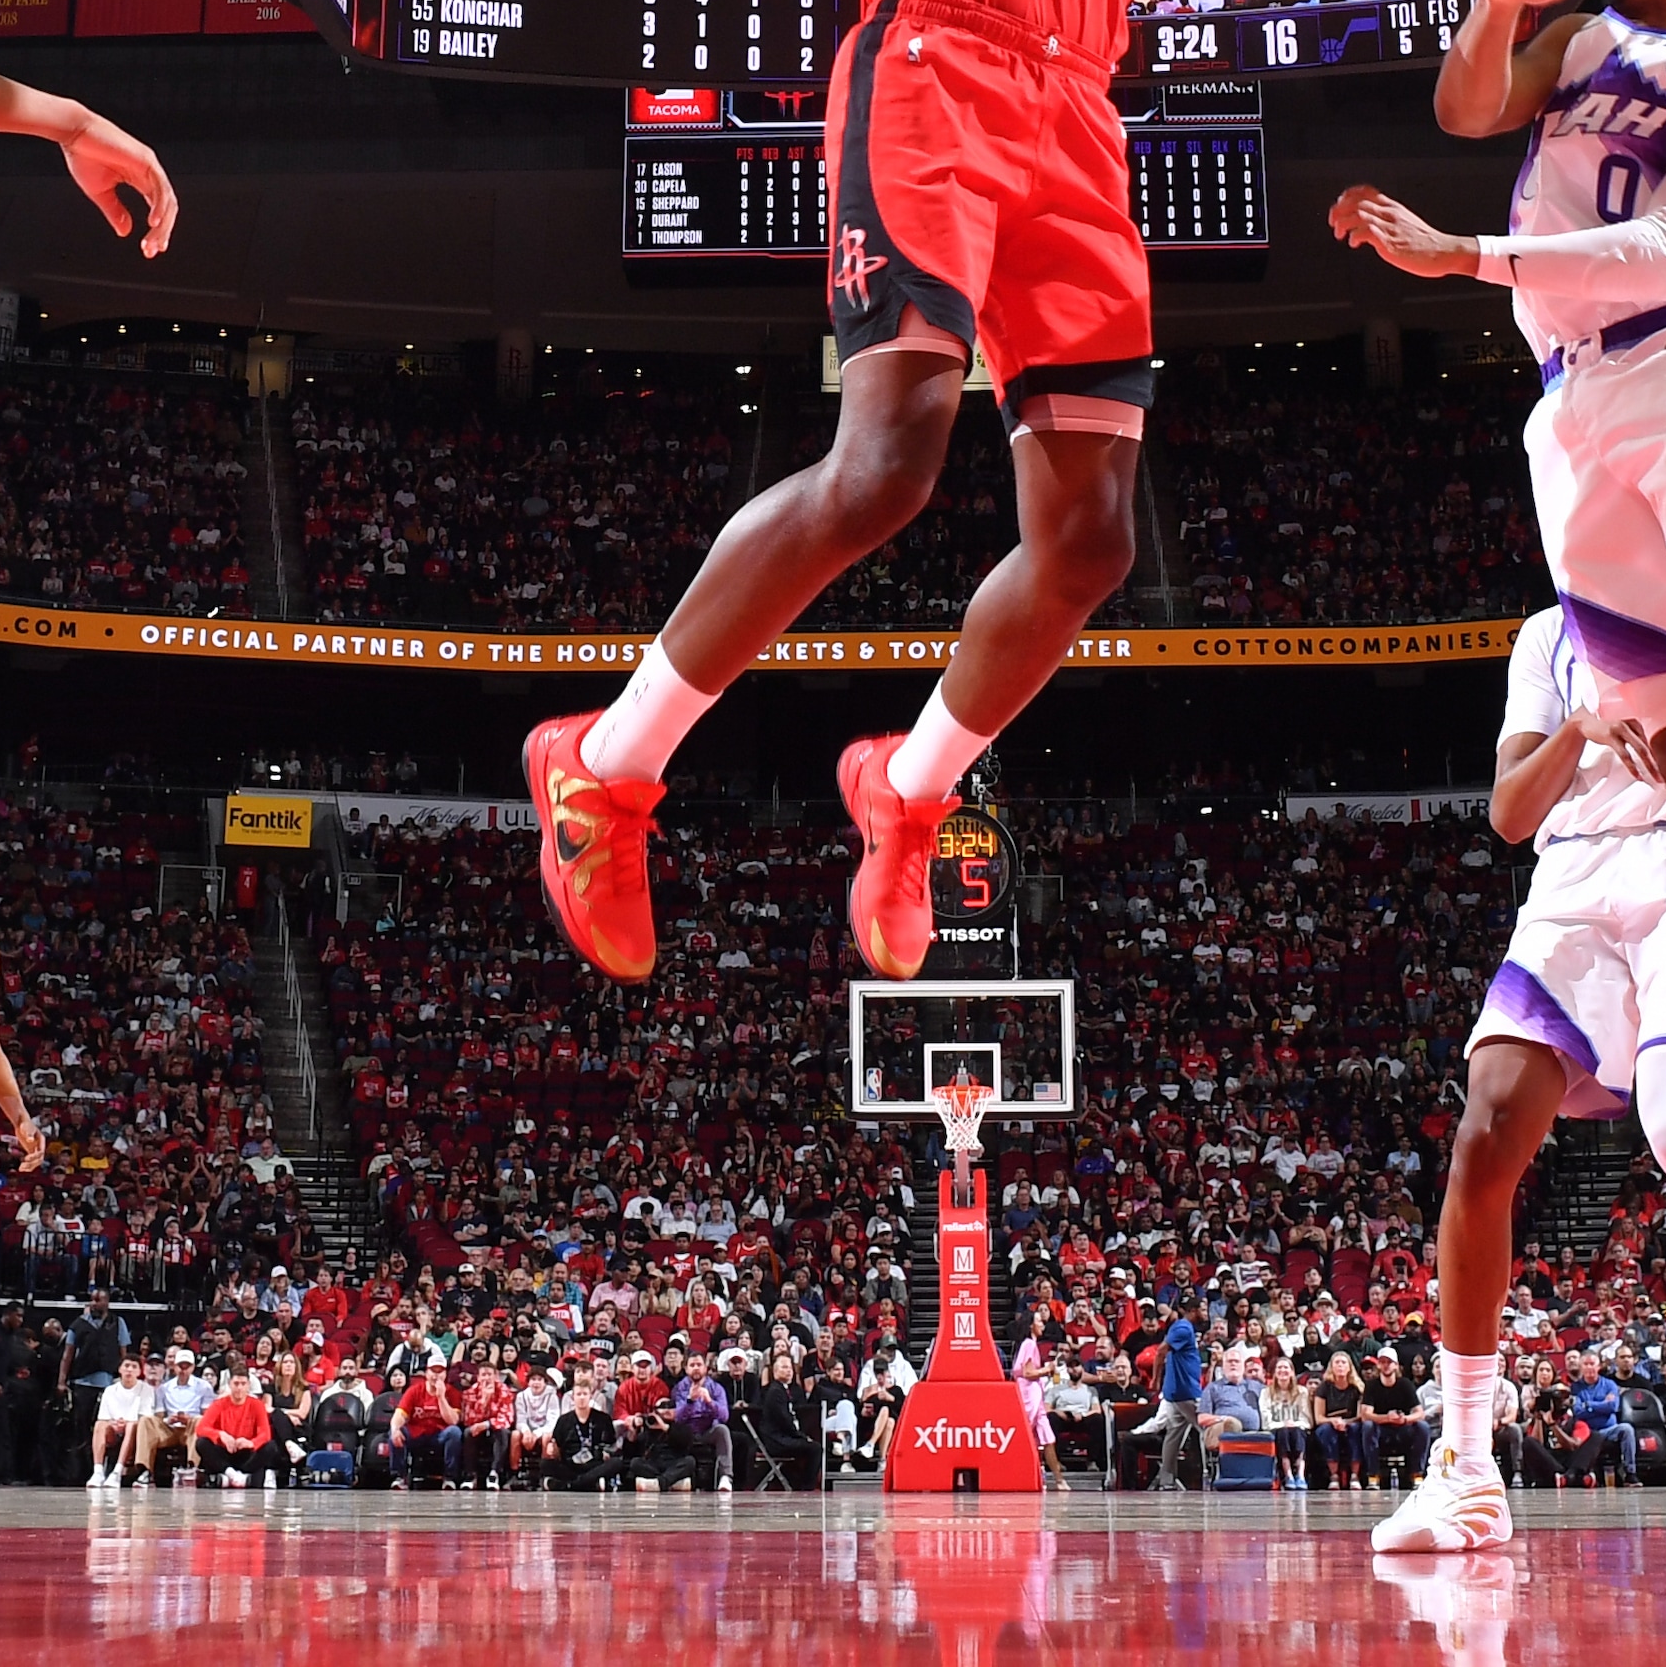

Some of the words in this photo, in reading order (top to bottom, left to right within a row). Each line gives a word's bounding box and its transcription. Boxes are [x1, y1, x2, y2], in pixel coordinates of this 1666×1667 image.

[255, 6, 281, 21] 2016
[1388, 2, 1420, 31] TOL
[1428, 0, 1459, 24] FLS
[413, 29, 429, 53] 19
[439, 30, 497, 58] BAILEY
[1158, 25, 1217, 60] 3:24
[1262, 19, 1297, 65] 16
[648, 105, 700, 115] TACOMA
[653, 163, 682, 176] EASON
[653, 180, 686, 193] CAPELA
[1597, 154, 1641, 224] 0
[652, 196, 699, 210] SHEPPARD
[652, 213, 688, 227] DURANT
[652, 230, 702, 244] THOMPSON
[139, 624, 281, 655] OFFICIAL
[291, 630, 427, 663] PARTNER
[436, 636, 478, 663] OF
[486, 638, 545, 665] THE
[858, 638, 878, 663] &
[229, 807, 303, 830] Fanttik
[939, 833, 995, 858] 3:24
[960, 859, 990, 908] 5
[939, 928, 1005, 941] TISSOT
[942, 1221, 974, 1232] reliant
[956, 1250, 971, 1269] M
[957, 1316, 972, 1335] M
[914, 1418, 1016, 1454] xfinity
